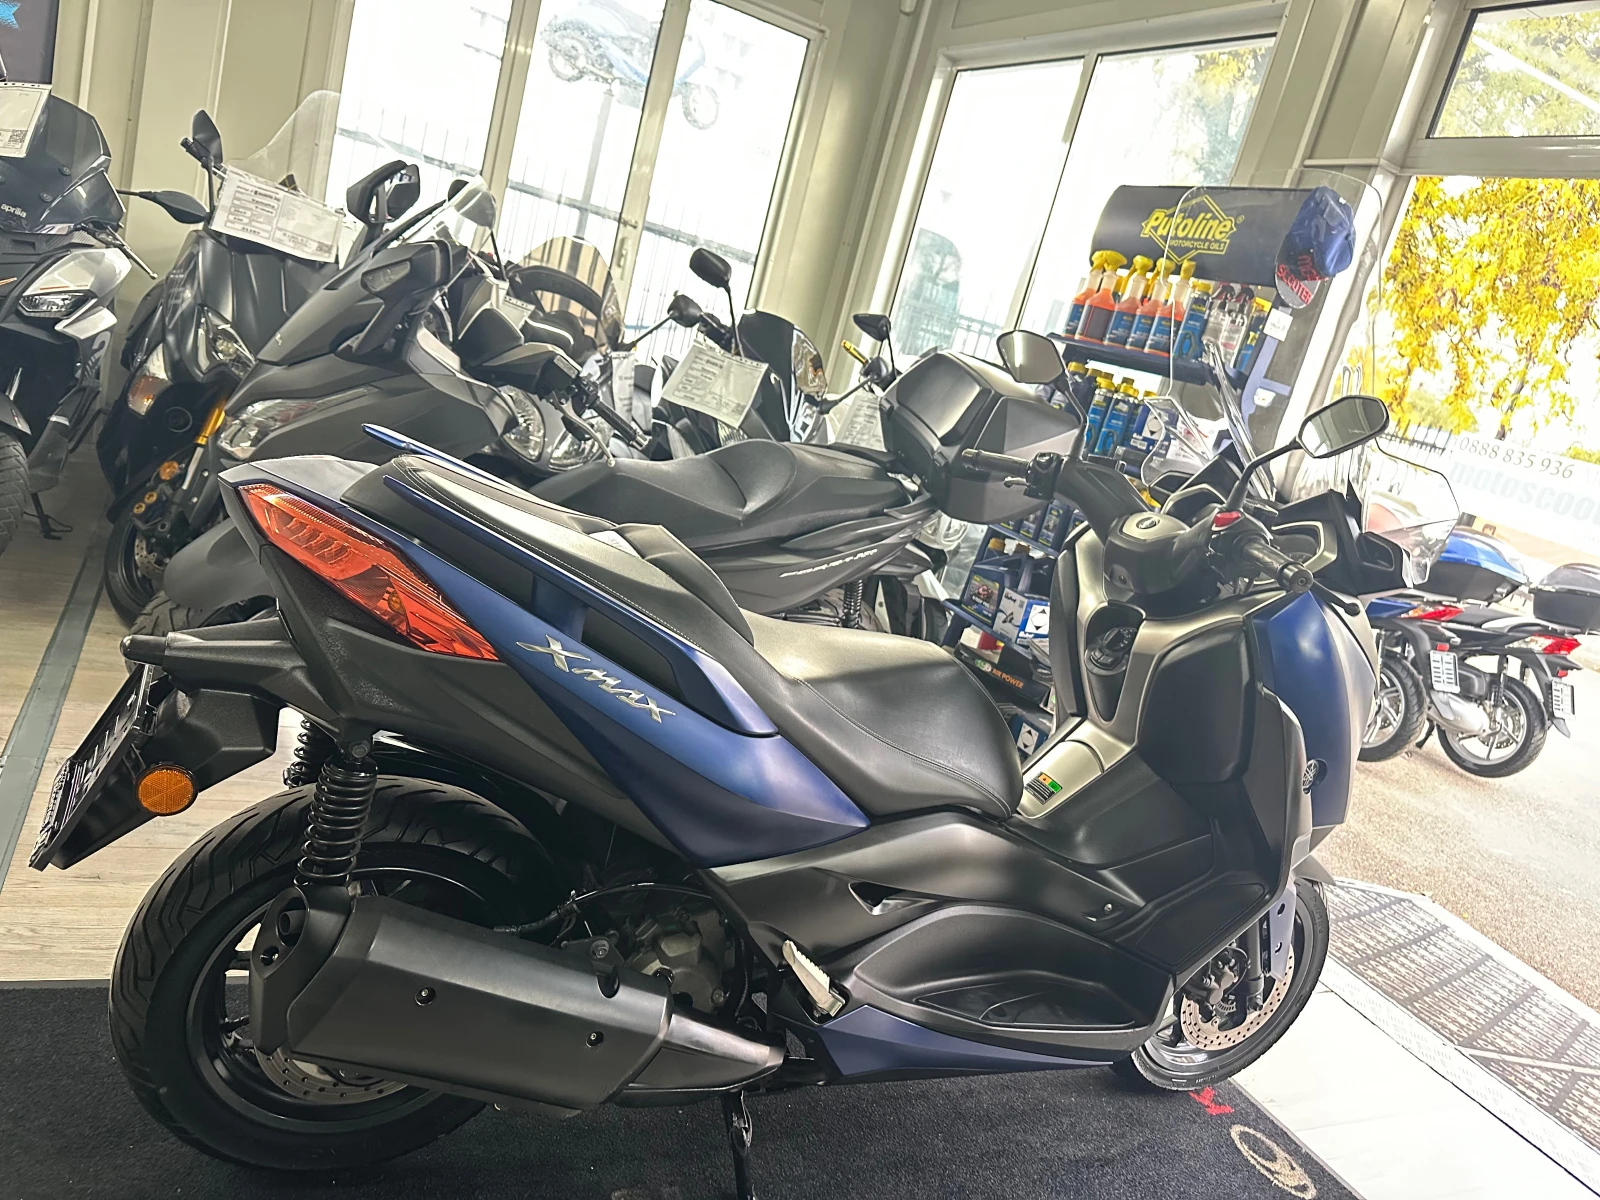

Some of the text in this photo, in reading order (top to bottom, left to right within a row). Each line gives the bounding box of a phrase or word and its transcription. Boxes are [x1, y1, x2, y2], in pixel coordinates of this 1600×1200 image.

[0, 203, 27, 218] aprilia
[1142, 210, 1233, 241] Putoline
[1169, 239, 1225, 251] MOTORCYCLE OILS
[1459, 436, 1500, 460] 0888
[1502, 448, 1537, 469] 835
[1538, 457, 1575, 479] 936
[1002, 671, 1024, 689] POWER
